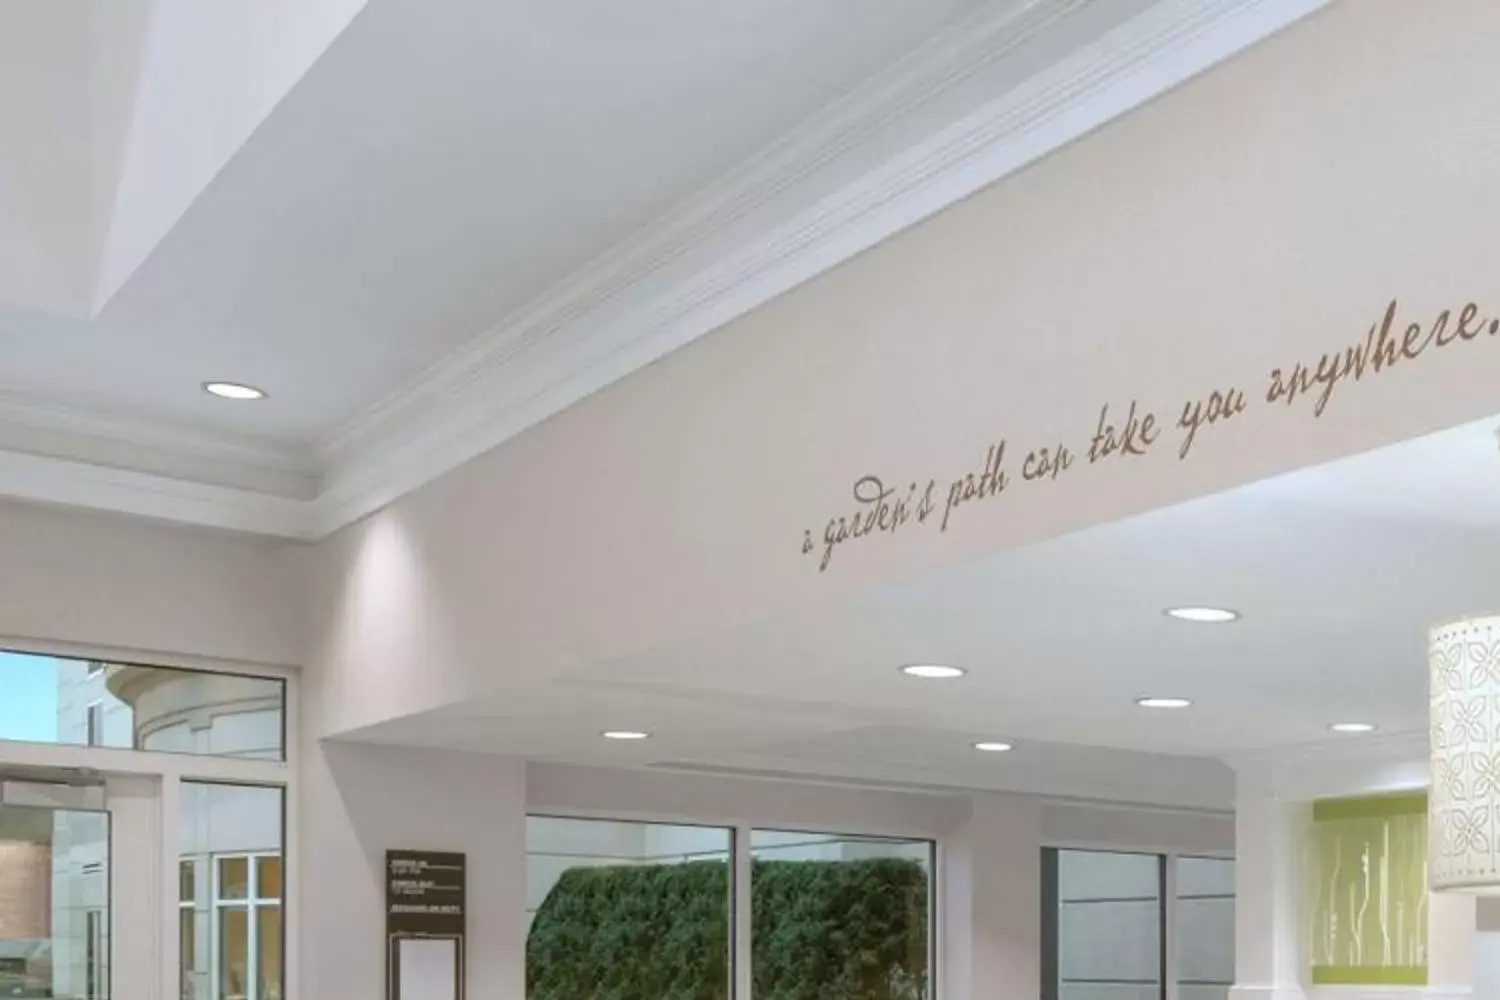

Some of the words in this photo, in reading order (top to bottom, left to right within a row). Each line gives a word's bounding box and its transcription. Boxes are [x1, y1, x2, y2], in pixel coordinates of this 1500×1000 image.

[802, 529, 814, 553] a
[820, 476, 935, 571] garden's
[941, 440, 1009, 531] path
[1022, 442, 1074, 481] can
[1088, 400, 1161, 464] take
[1176, 388, 1247, 460] you
